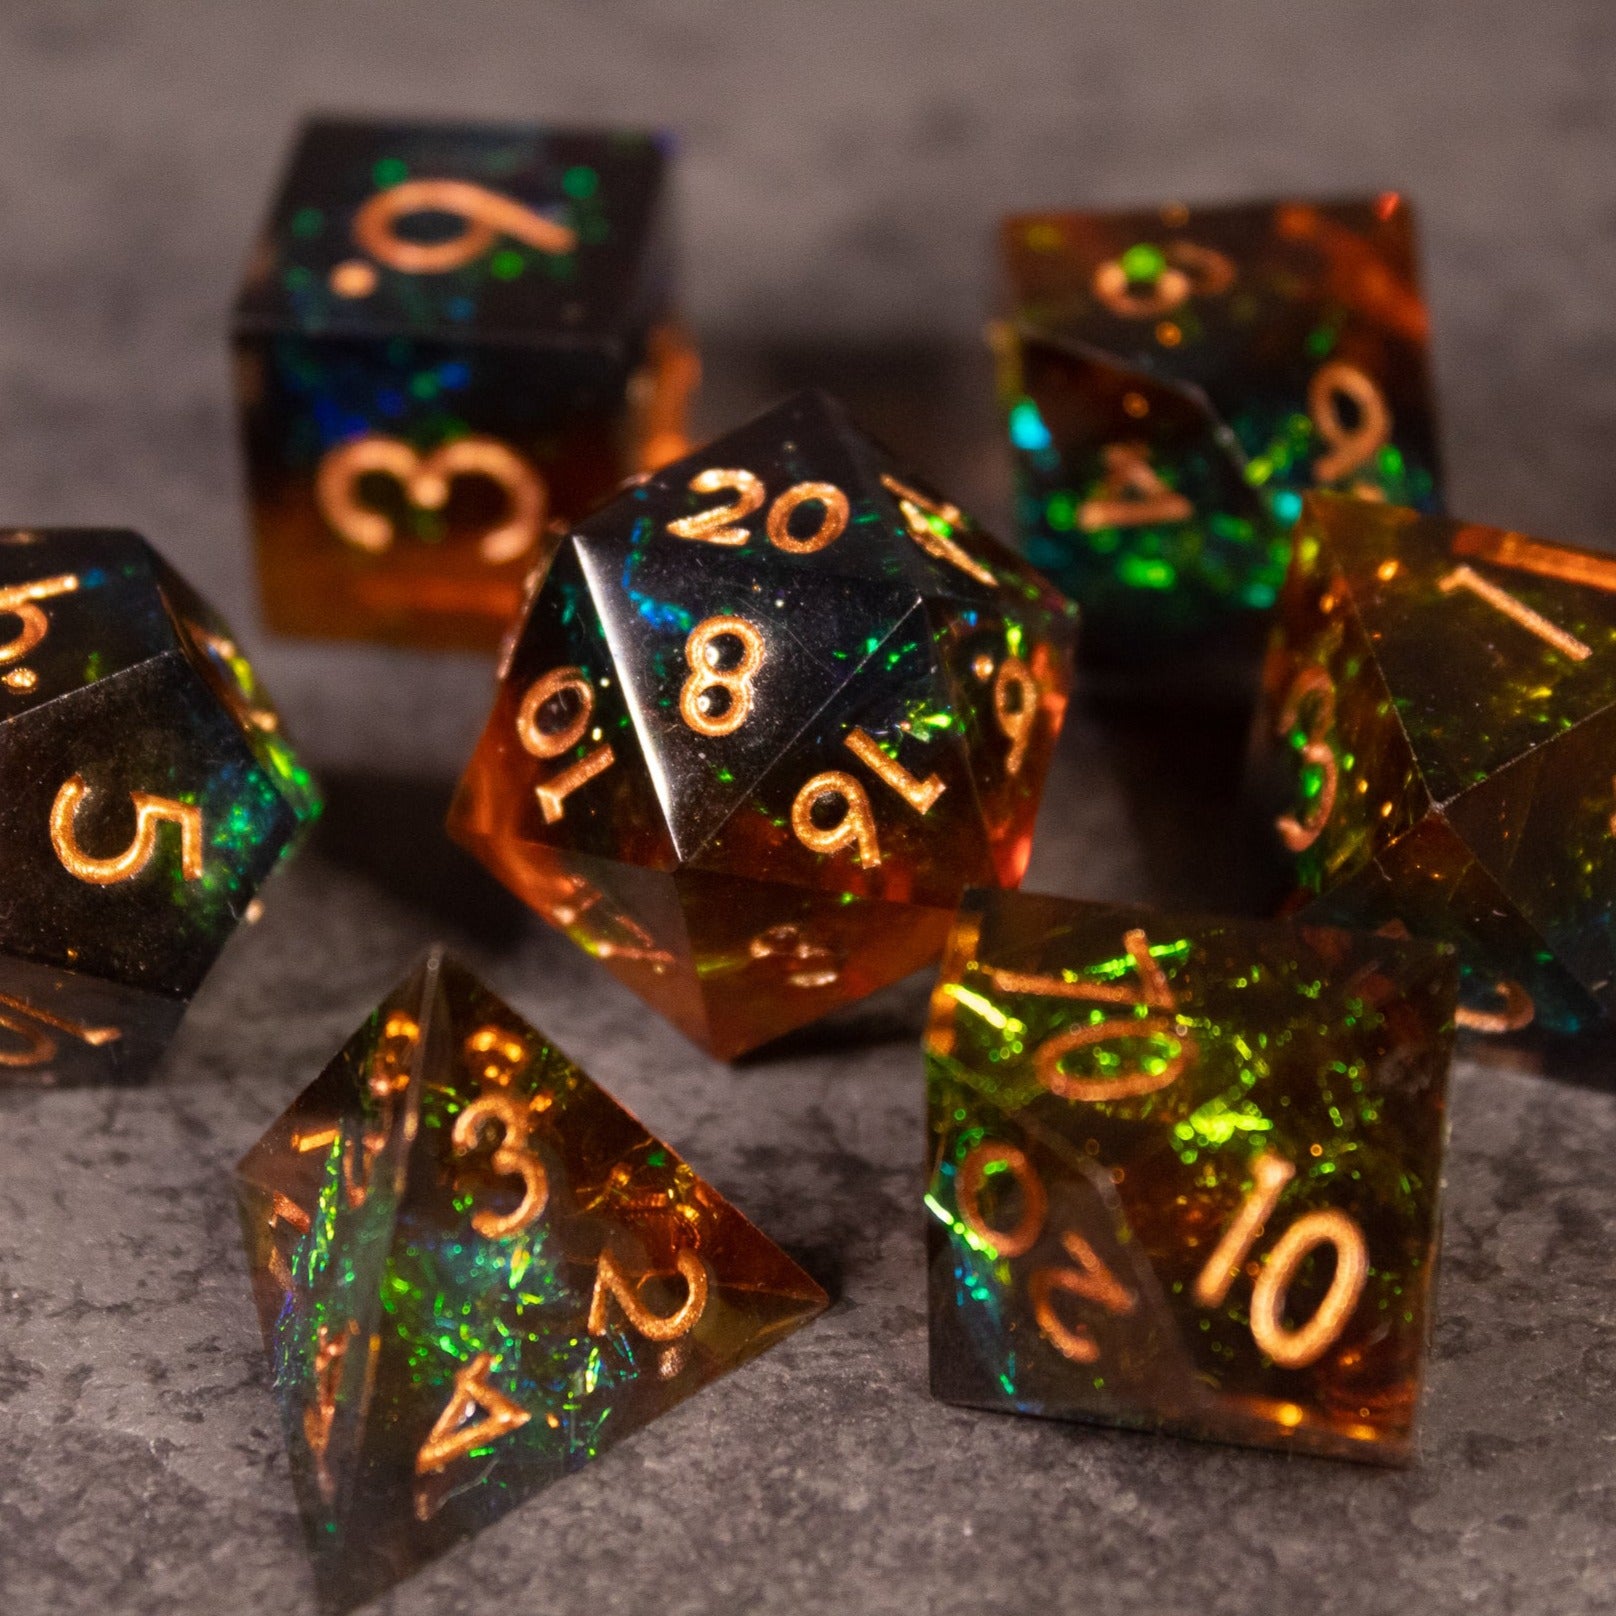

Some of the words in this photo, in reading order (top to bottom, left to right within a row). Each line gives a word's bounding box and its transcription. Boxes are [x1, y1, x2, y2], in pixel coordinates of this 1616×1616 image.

[315, 435, 546, 564] 3
[667, 469, 850, 553] 20
[1075, 444, 1193, 533] 4
[680, 615, 765, 737] 8
[1438, 565, 1593, 660] 1
[516, 666, 615, 823] 10
[791, 726, 946, 870] 16
[1278, 664, 1337, 851] 3
[50, 772, 203, 884] 5
[453, 1094, 549, 1241] 3
[955, 1141, 1137, 1364] 20
[1200, 1153, 1369, 1368] 10
[416, 1352, 532, 1474] 4
